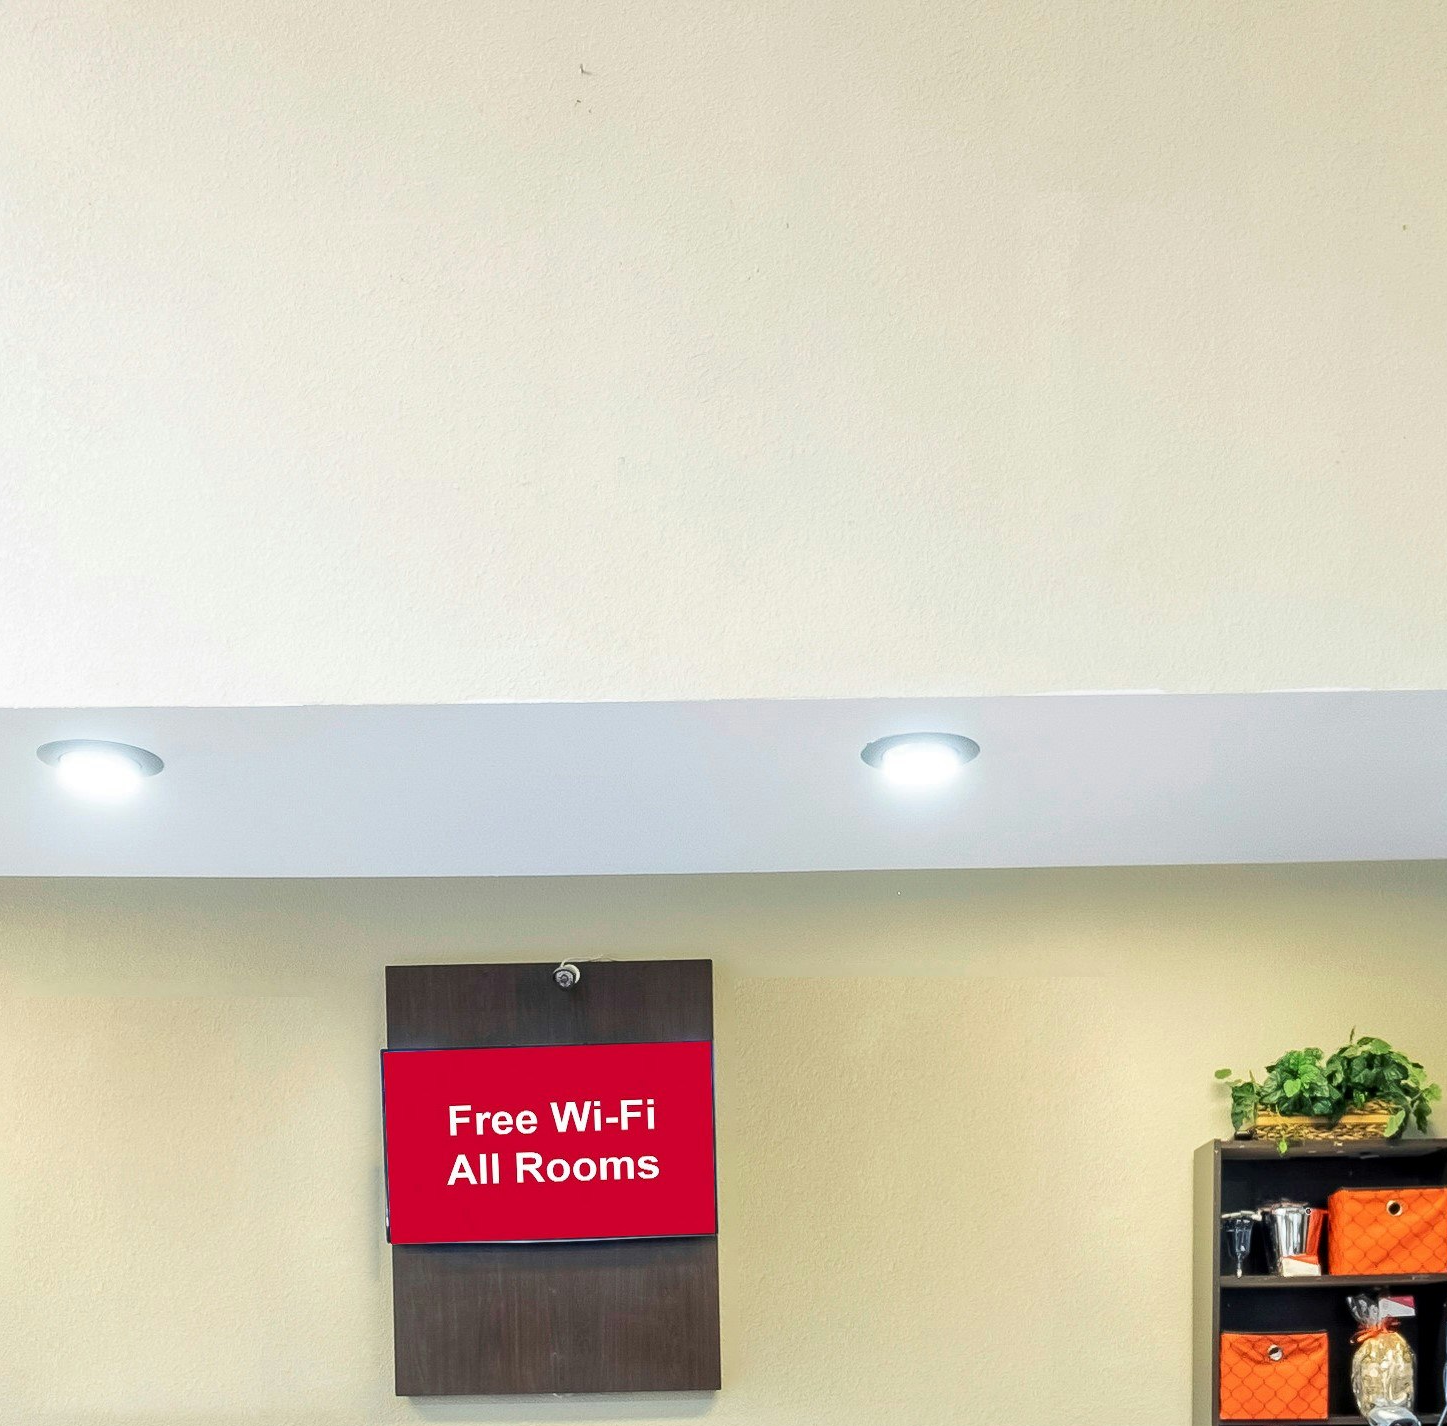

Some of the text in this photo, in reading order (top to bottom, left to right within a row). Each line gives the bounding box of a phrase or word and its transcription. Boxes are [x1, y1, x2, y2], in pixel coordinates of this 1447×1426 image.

[449, 1098, 655, 1136] Free Wi-Fi
[446, 1151, 660, 1186] All Rooms
